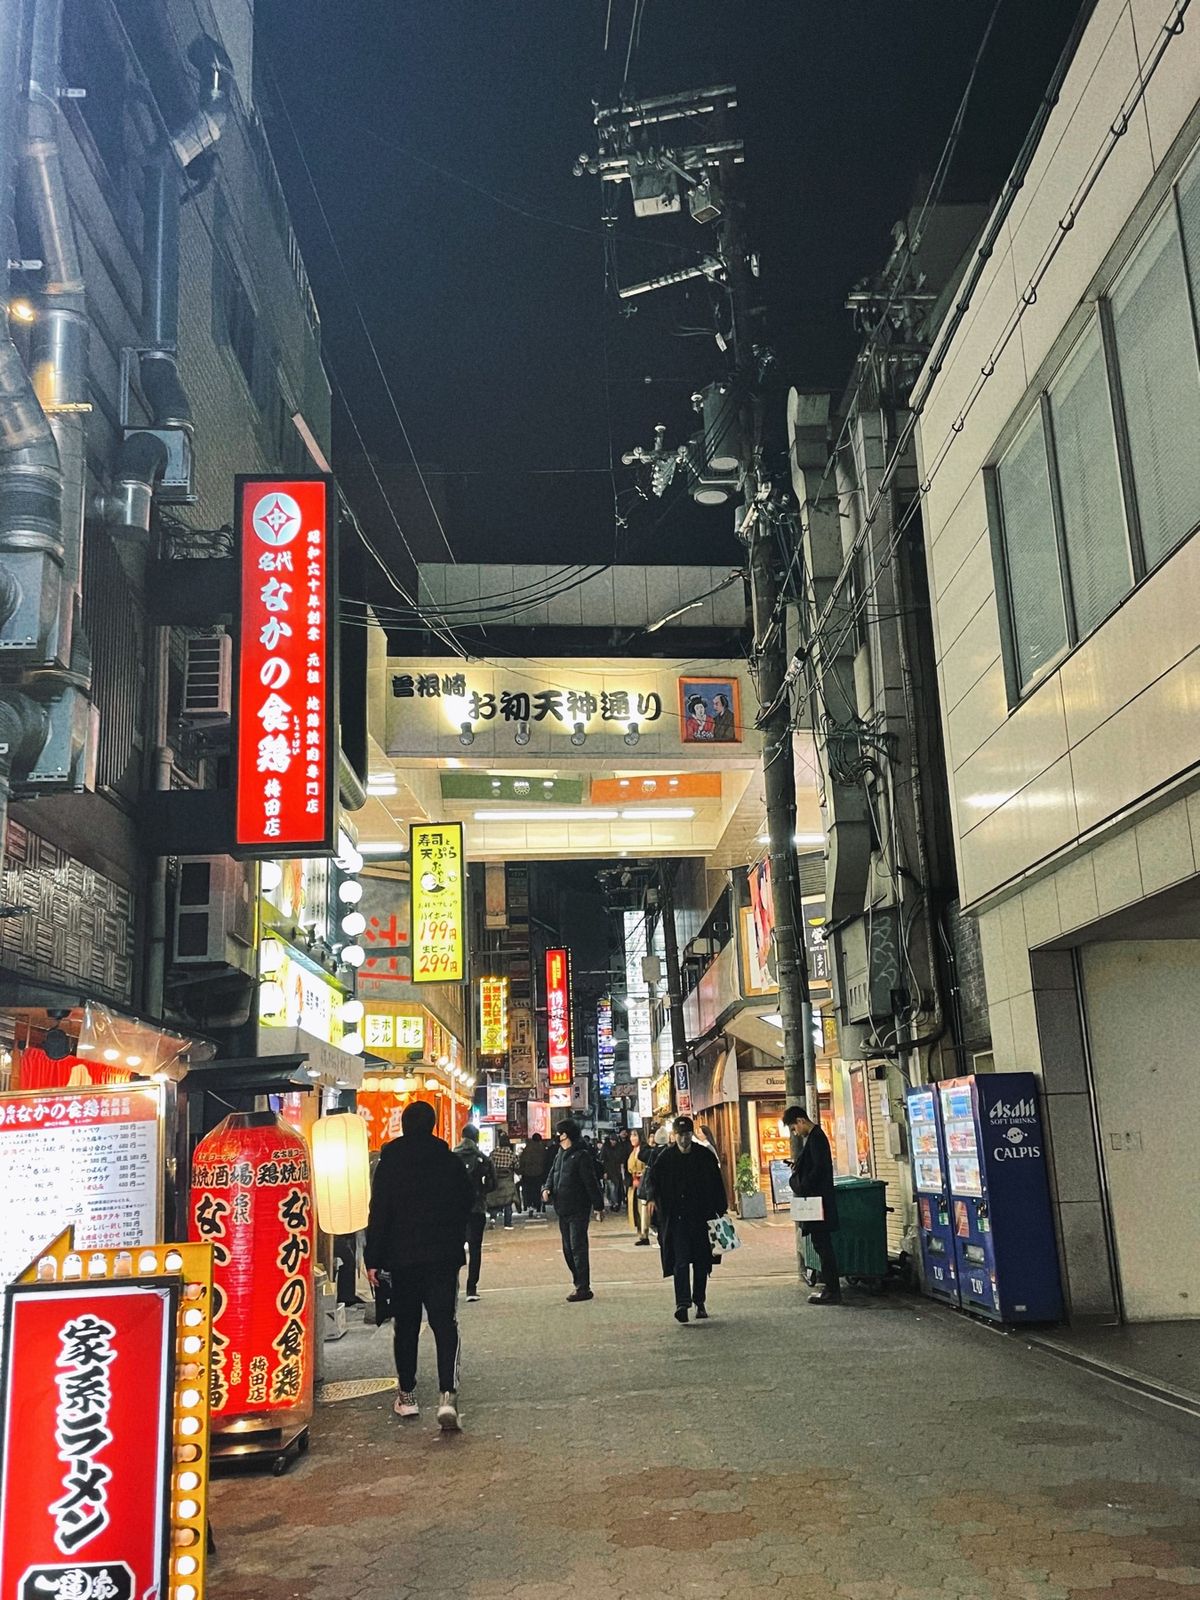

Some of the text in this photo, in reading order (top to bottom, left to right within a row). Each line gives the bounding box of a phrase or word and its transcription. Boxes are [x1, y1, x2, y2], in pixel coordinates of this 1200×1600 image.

[267, 508, 287, 531] 中
[258, 551, 294, 573] 名代
[257, 576, 293, 774] なかの食鶏
[468, 689, 662, 722] お初天神通り
[263, 778, 281, 837] 梅田店
[420, 845, 458, 860] 天ぷら
[420, 921, 458, 941] 199円
[419, 953, 458, 974] 299円
[17, 1098, 100, 1122] なかの食鶏
[989, 1097, 1037, 1120] Asahi
[990, 1117, 1037, 1126] SOFT DRINKS
[993, 1146, 1041, 1162] CALPIS
[233, 1193, 250, 1223] 名代
[273, 1190, 310, 1399] なかの食鶏
[248, 1356, 267, 1402] 梅田店
[57, 1317, 114, 1550] 家系ラーメン
